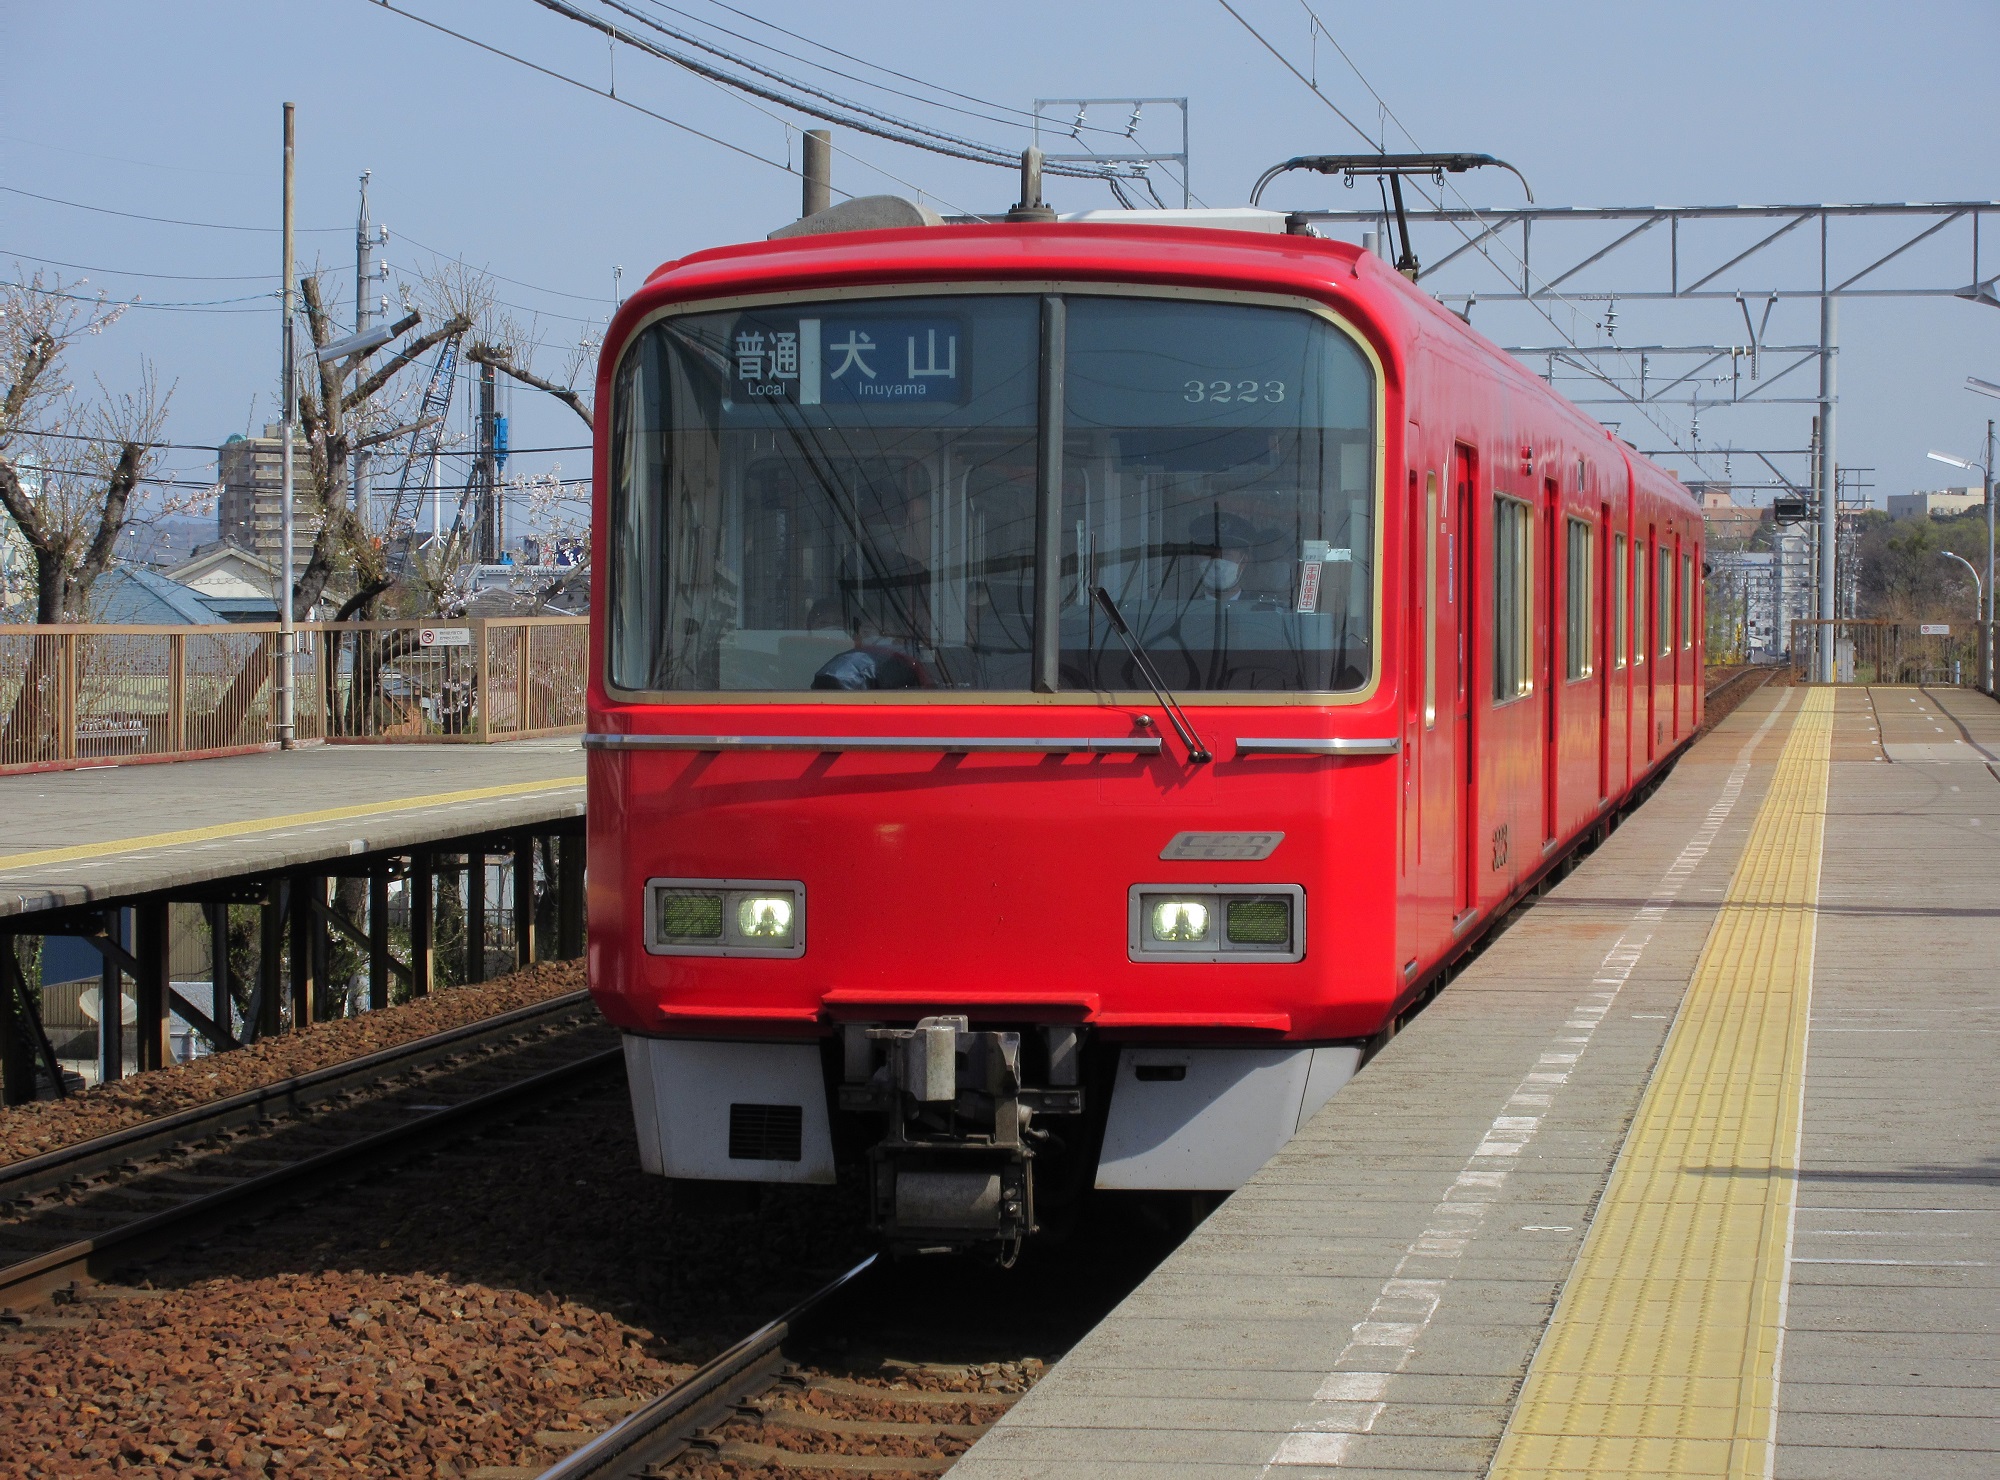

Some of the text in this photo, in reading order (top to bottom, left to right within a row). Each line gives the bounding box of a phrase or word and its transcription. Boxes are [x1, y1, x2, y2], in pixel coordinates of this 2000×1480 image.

[736, 331, 798, 380] 普通
[830, 329, 956, 380] 犬山
[748, 382, 785, 396] Local
[859, 382, 927, 398] Inuyama
[1184, 380, 1285, 403] 3223
